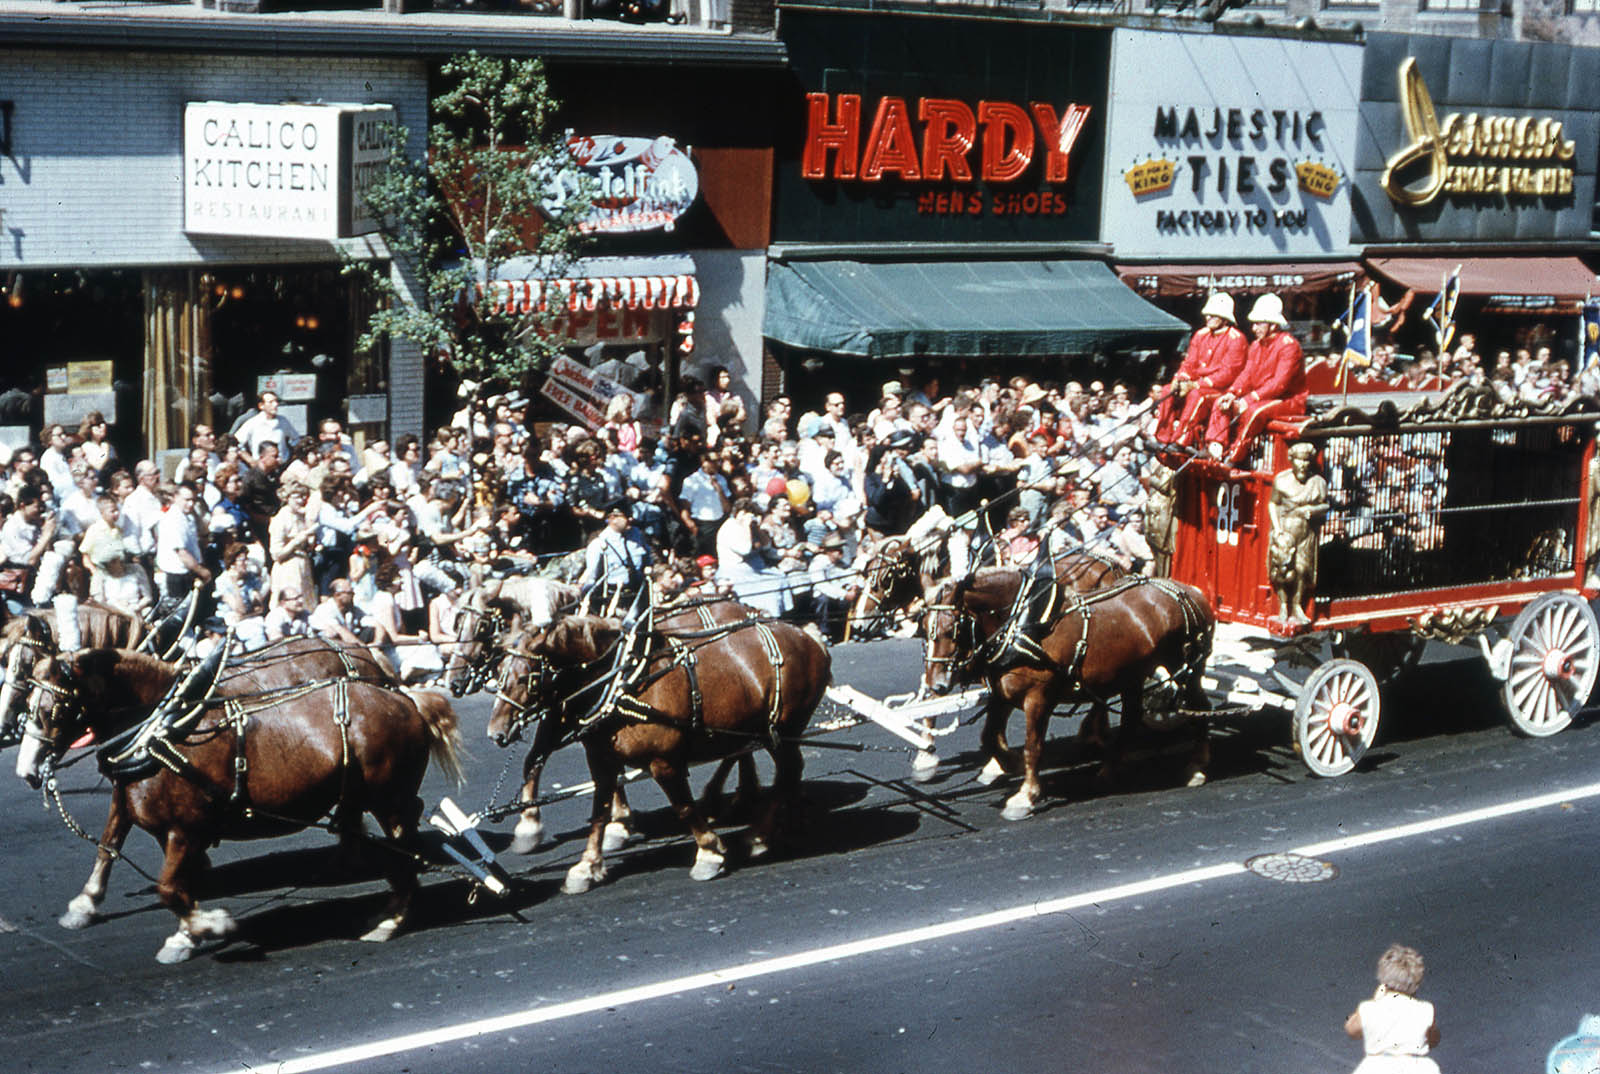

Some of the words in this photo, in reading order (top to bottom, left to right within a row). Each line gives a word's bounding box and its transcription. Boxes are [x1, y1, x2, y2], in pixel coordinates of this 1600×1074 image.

[203, 118, 317, 151] CALICO
[1153, 106, 1322, 141] MAJESTIC
[802, 92, 1092, 184] HARDY
[193, 158, 328, 191] KITCHEN
[1134, 174, 1170, 189] KING
[1187, 155, 1287, 193] TIES
[1300, 175, 1333, 192] KING
[193, 201, 328, 222] RESTAURANT
[992, 192, 1067, 215] SHOES
[1156, 210, 1239, 232] FACTORY
[1245, 211, 1268, 231] TO
[1273, 211, 1307, 231] YOU
[1196, 275, 1268, 288] MAJESTIC
[1273, 274, 1305, 287] TIES
